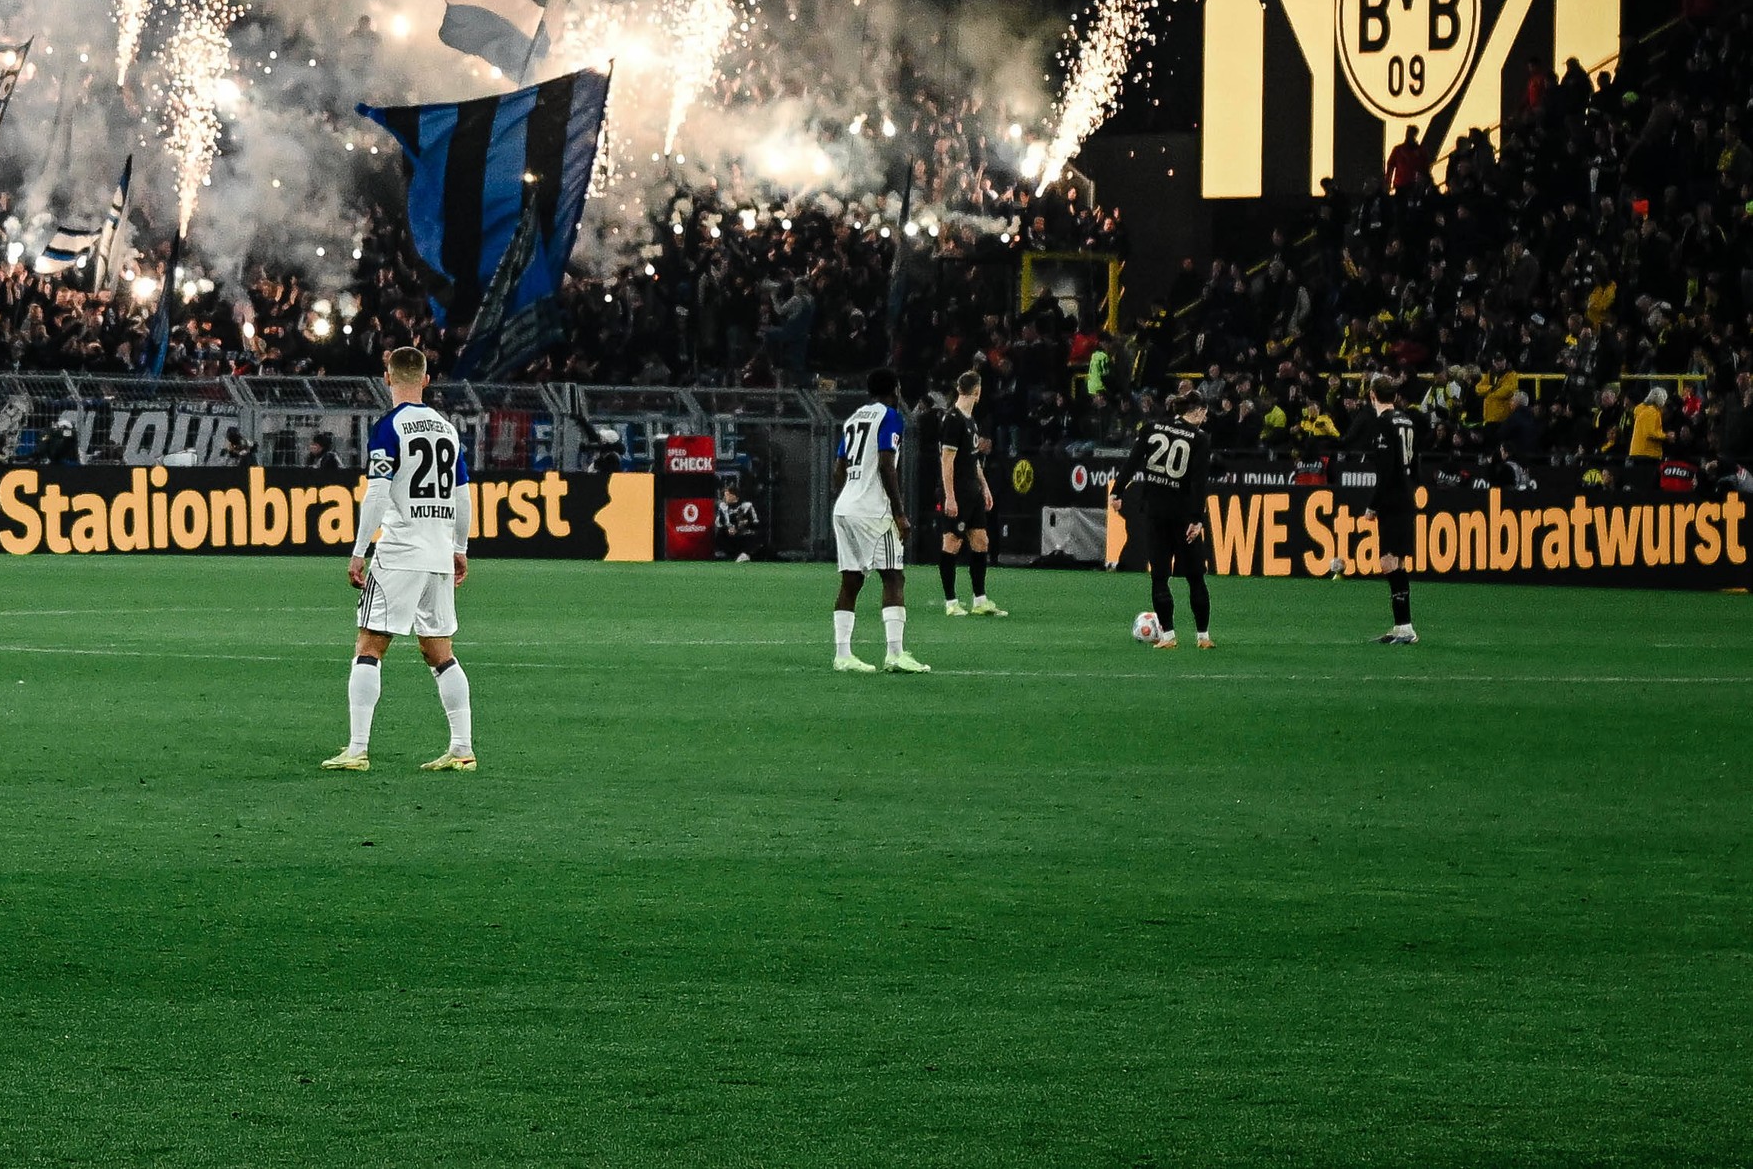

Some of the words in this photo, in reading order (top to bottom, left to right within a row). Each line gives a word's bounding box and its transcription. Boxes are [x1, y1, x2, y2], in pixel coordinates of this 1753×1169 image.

[1387, 54, 1426, 98] 09
[408, 436, 456, 500] 28
[671, 456, 713, 472] CHECK
[845, 421, 872, 468] 27
[1145, 432, 1191, 479] 20
[1303, 485, 1748, 577] Staionbratwurst
